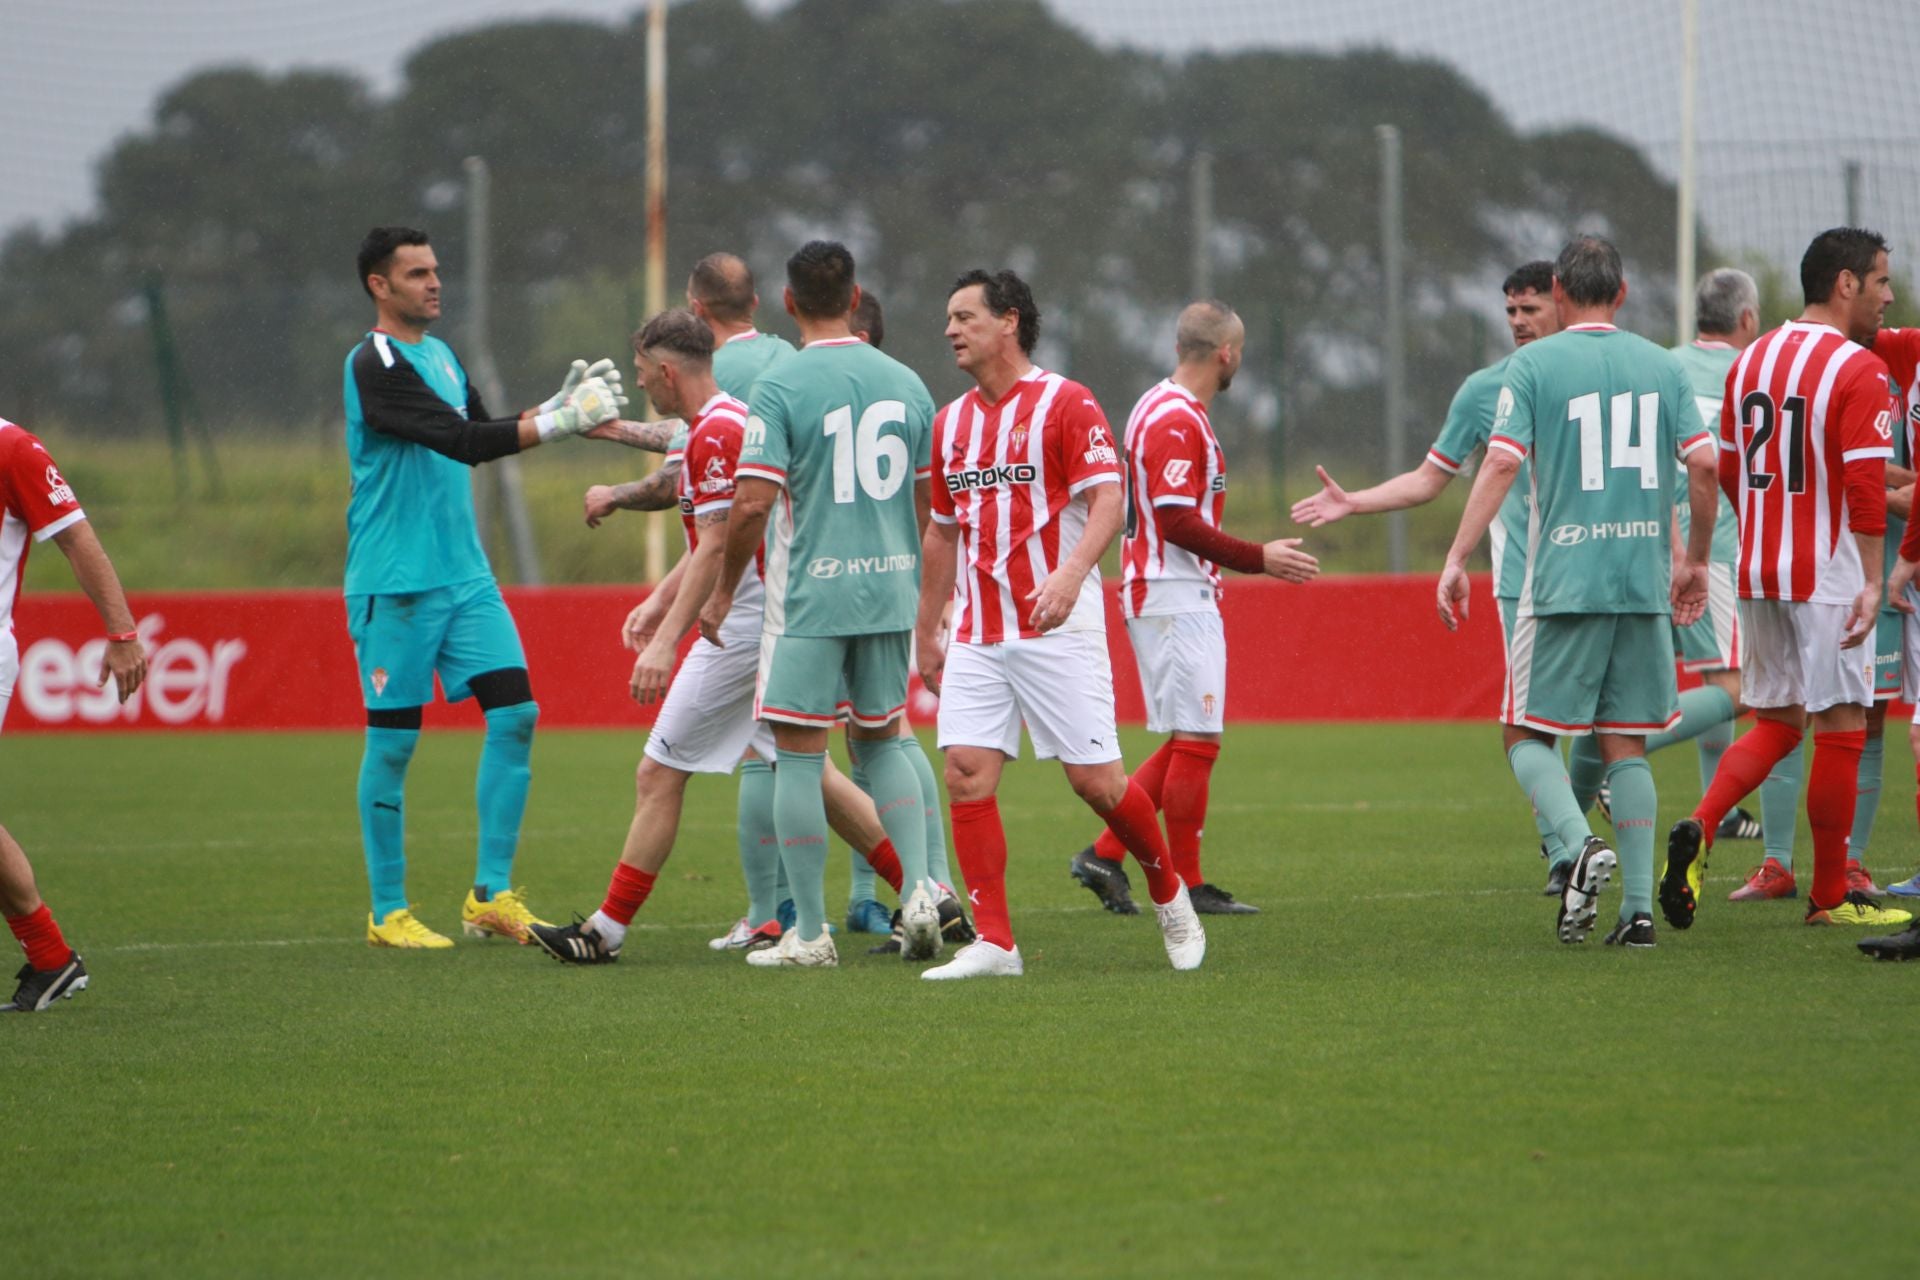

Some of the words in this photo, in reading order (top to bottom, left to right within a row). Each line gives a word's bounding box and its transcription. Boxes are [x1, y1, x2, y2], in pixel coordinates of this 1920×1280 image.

[823, 400, 908, 503] 16
[946, 464, 1037, 492] SIROKO
[1568, 391, 1660, 491] 14
[1741, 391, 1807, 494] 21
